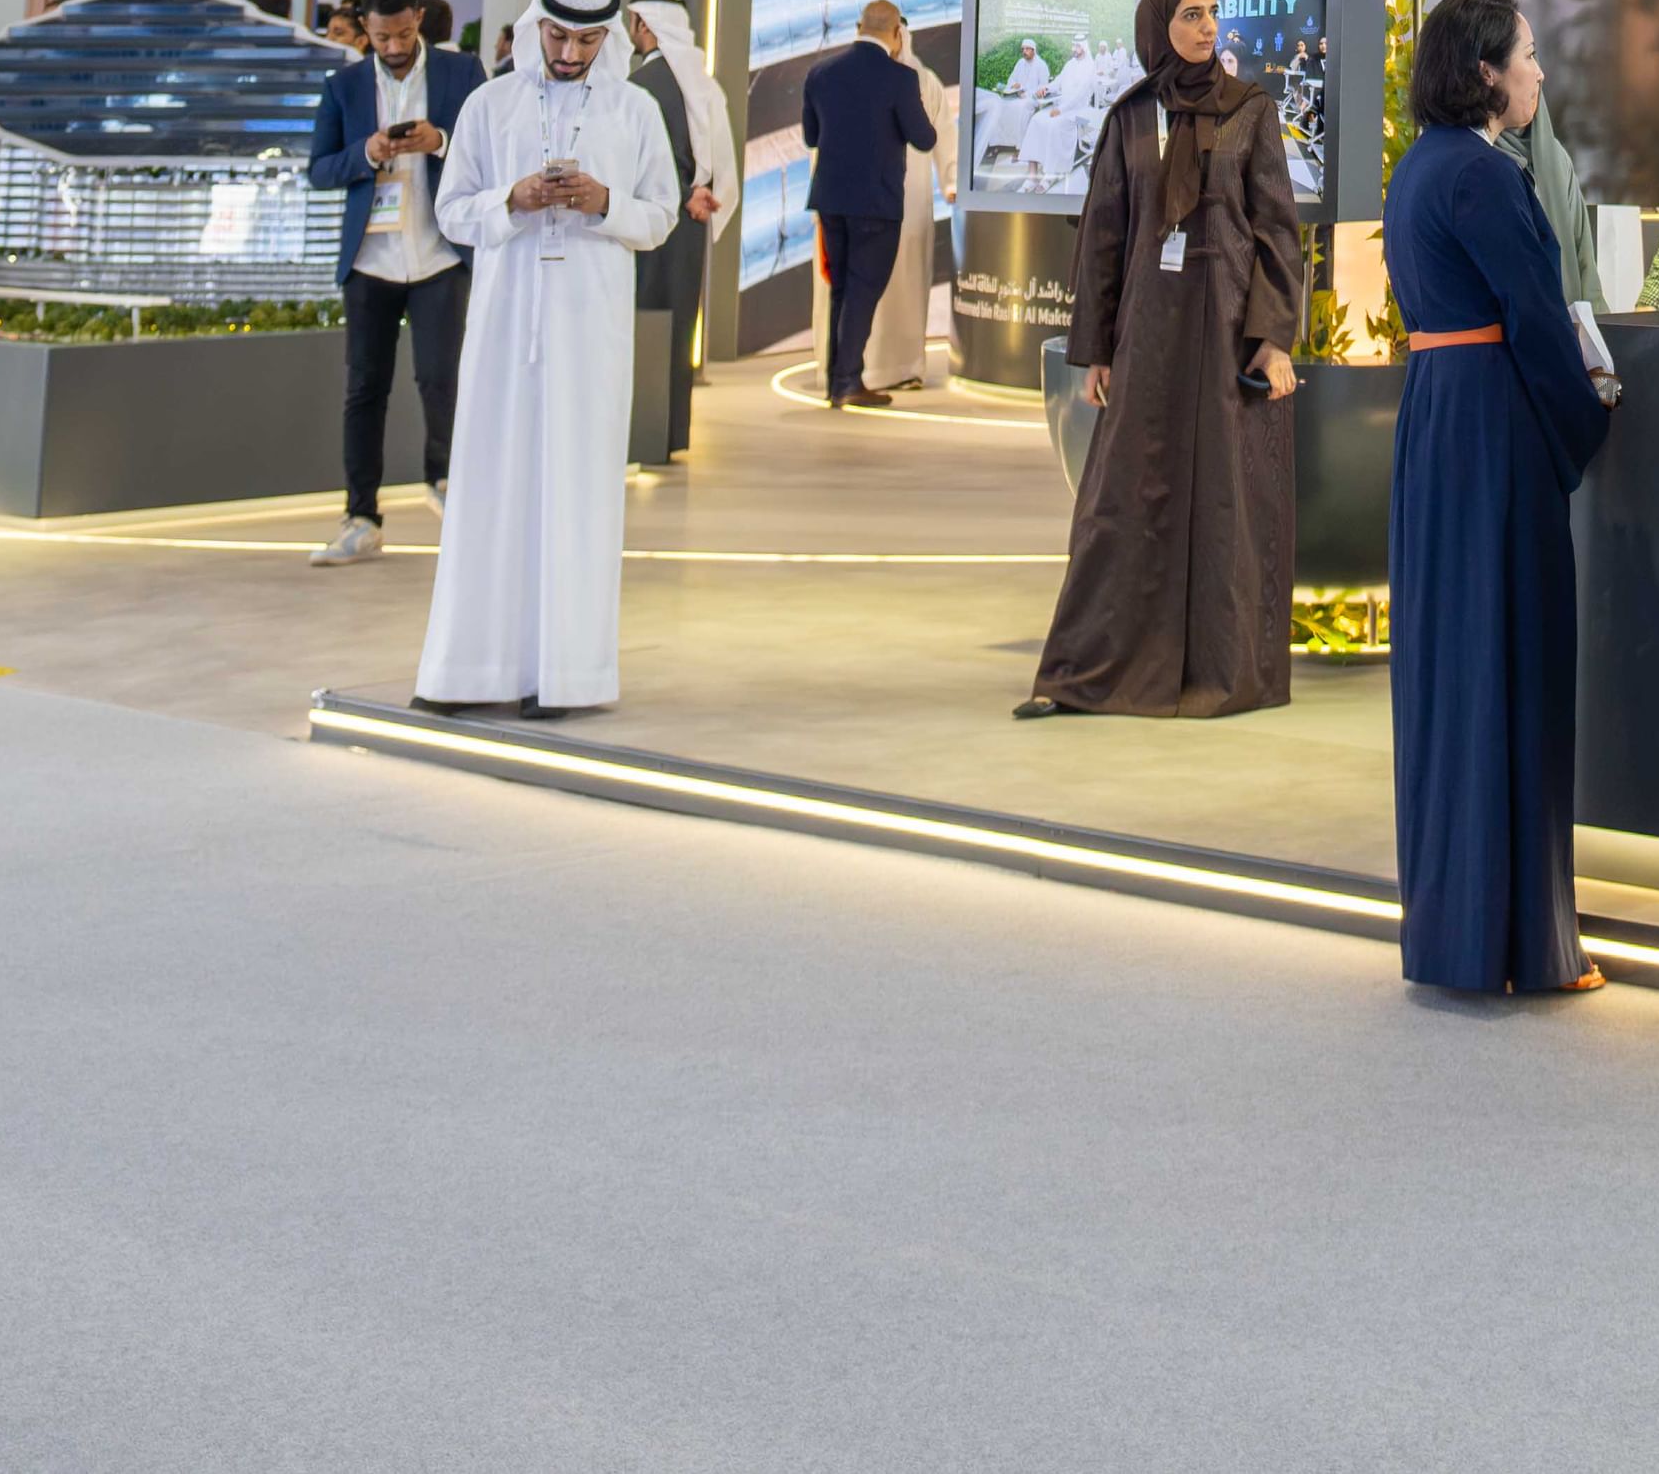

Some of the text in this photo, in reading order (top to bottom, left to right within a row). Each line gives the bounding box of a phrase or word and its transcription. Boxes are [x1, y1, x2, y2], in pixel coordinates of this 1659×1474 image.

[1037, 280, 1063, 303] راشد
[1024, 305, 1037, 324] Al
[1038, 307, 1072, 326] Makto
